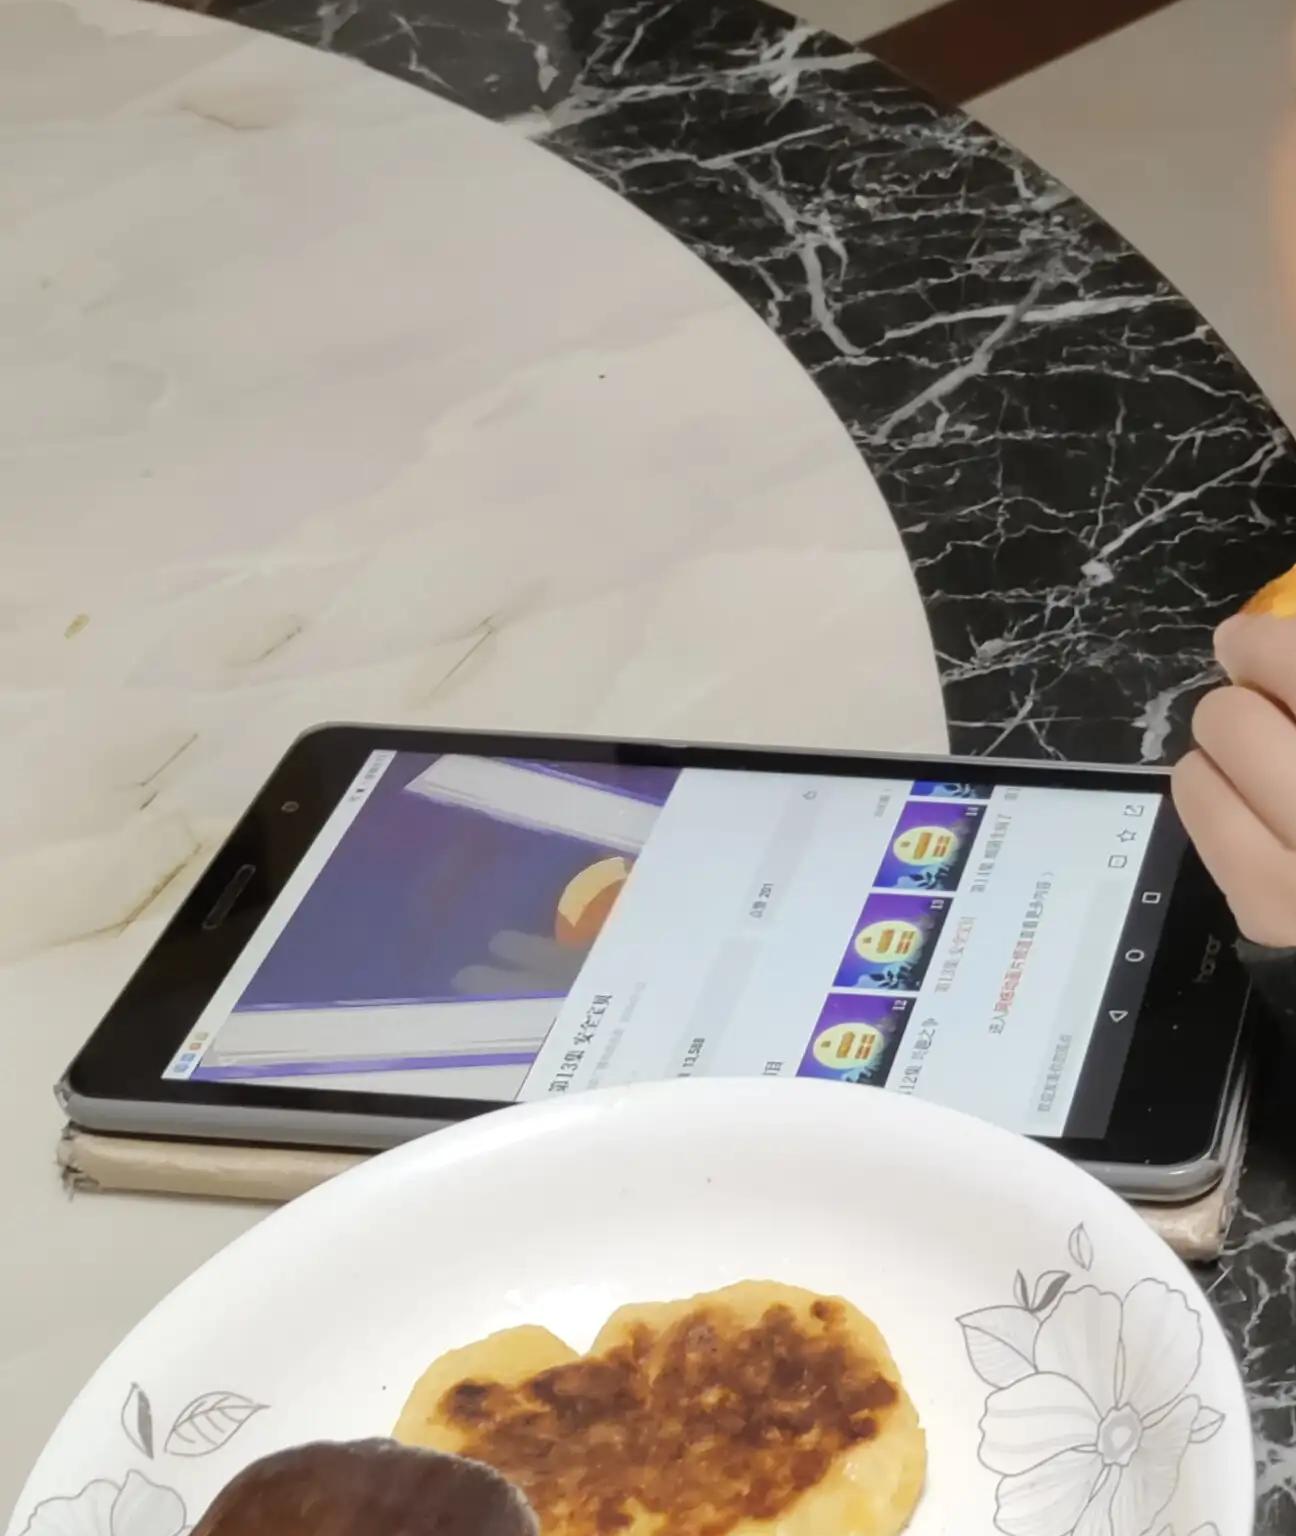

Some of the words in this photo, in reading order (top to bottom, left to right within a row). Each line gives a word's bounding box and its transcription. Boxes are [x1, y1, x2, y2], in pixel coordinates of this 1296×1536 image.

[548, 1050, 585, 1092] 第13集
[573, 995, 613, 1045] 安全宝贝
